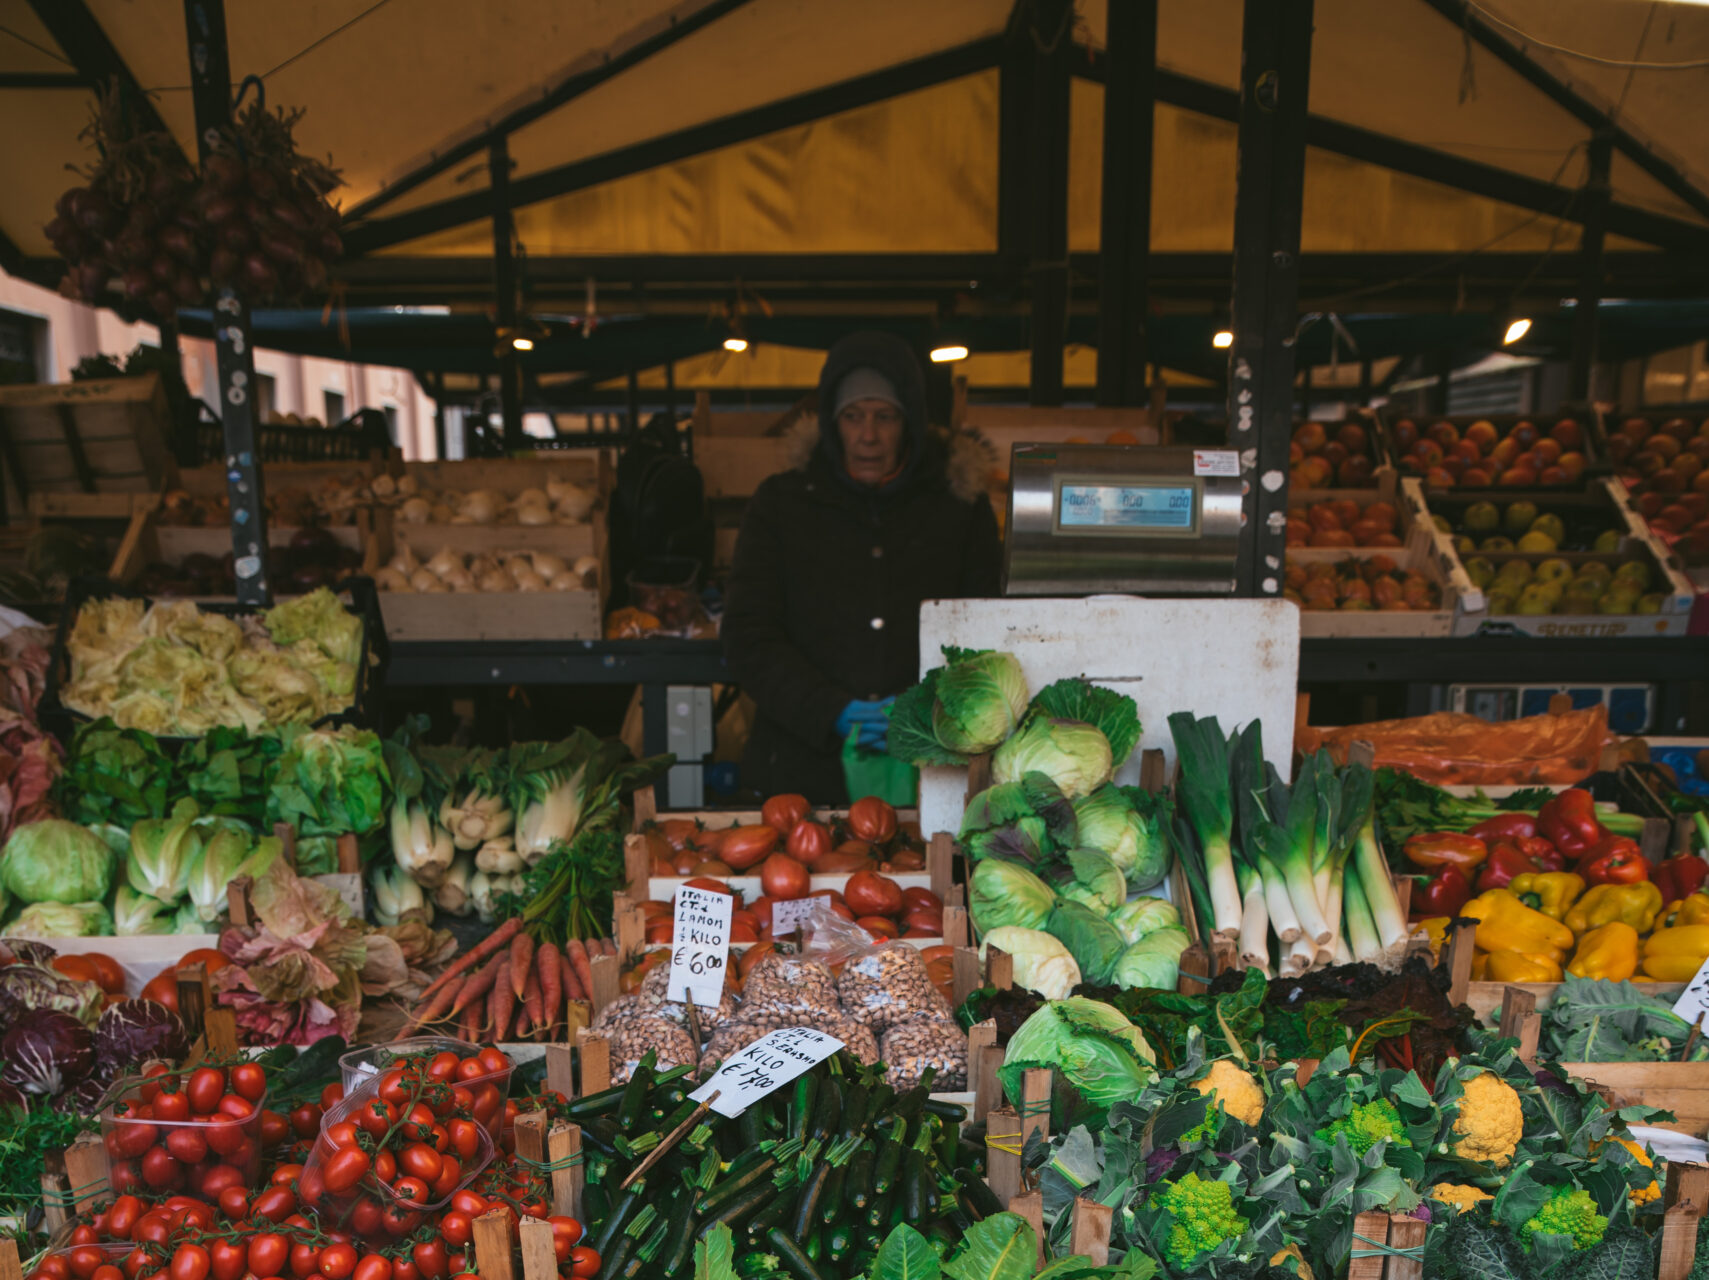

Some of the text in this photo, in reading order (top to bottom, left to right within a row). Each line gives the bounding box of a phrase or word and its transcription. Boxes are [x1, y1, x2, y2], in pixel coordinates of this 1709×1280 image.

[682, 890, 723, 905] ITALIA
[690, 929, 722, 946] KILO
[674, 946, 686, 966] €
[743, 1047, 785, 1070] KILO
[721, 1062, 747, 1076] €
